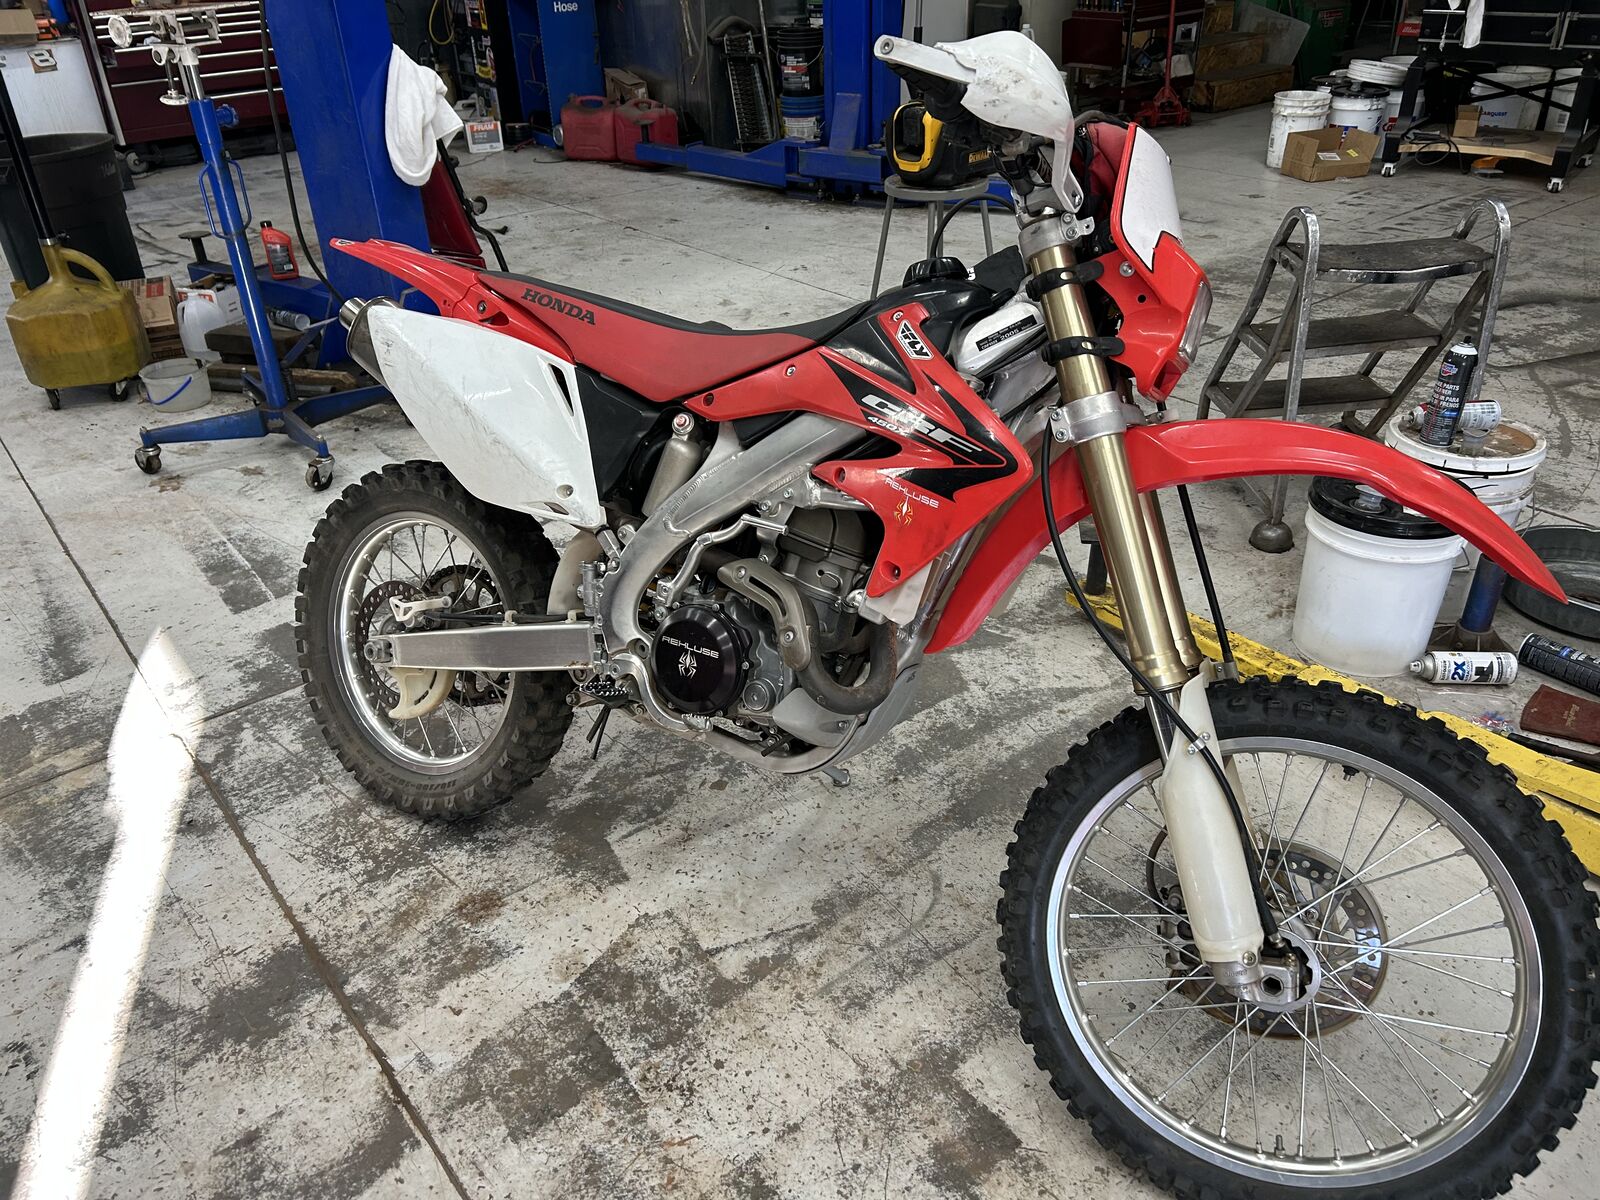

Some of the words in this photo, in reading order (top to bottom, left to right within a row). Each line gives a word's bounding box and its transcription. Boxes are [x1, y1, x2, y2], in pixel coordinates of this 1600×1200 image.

[553, 2, 578, 13] Hose
[28, 49, 57, 67] 8
[473, 123, 495, 132] FRAM
[521, 288, 596, 325] HONDA
[900, 322, 931, 357] FLY
[1000, 328, 1020, 341] 2005
[861, 394, 983, 453] CRF
[885, 477, 939, 509] REKLUSE
[662, 635, 719, 659] REKLUSE
[1450, 660, 1466, 681] 2X
